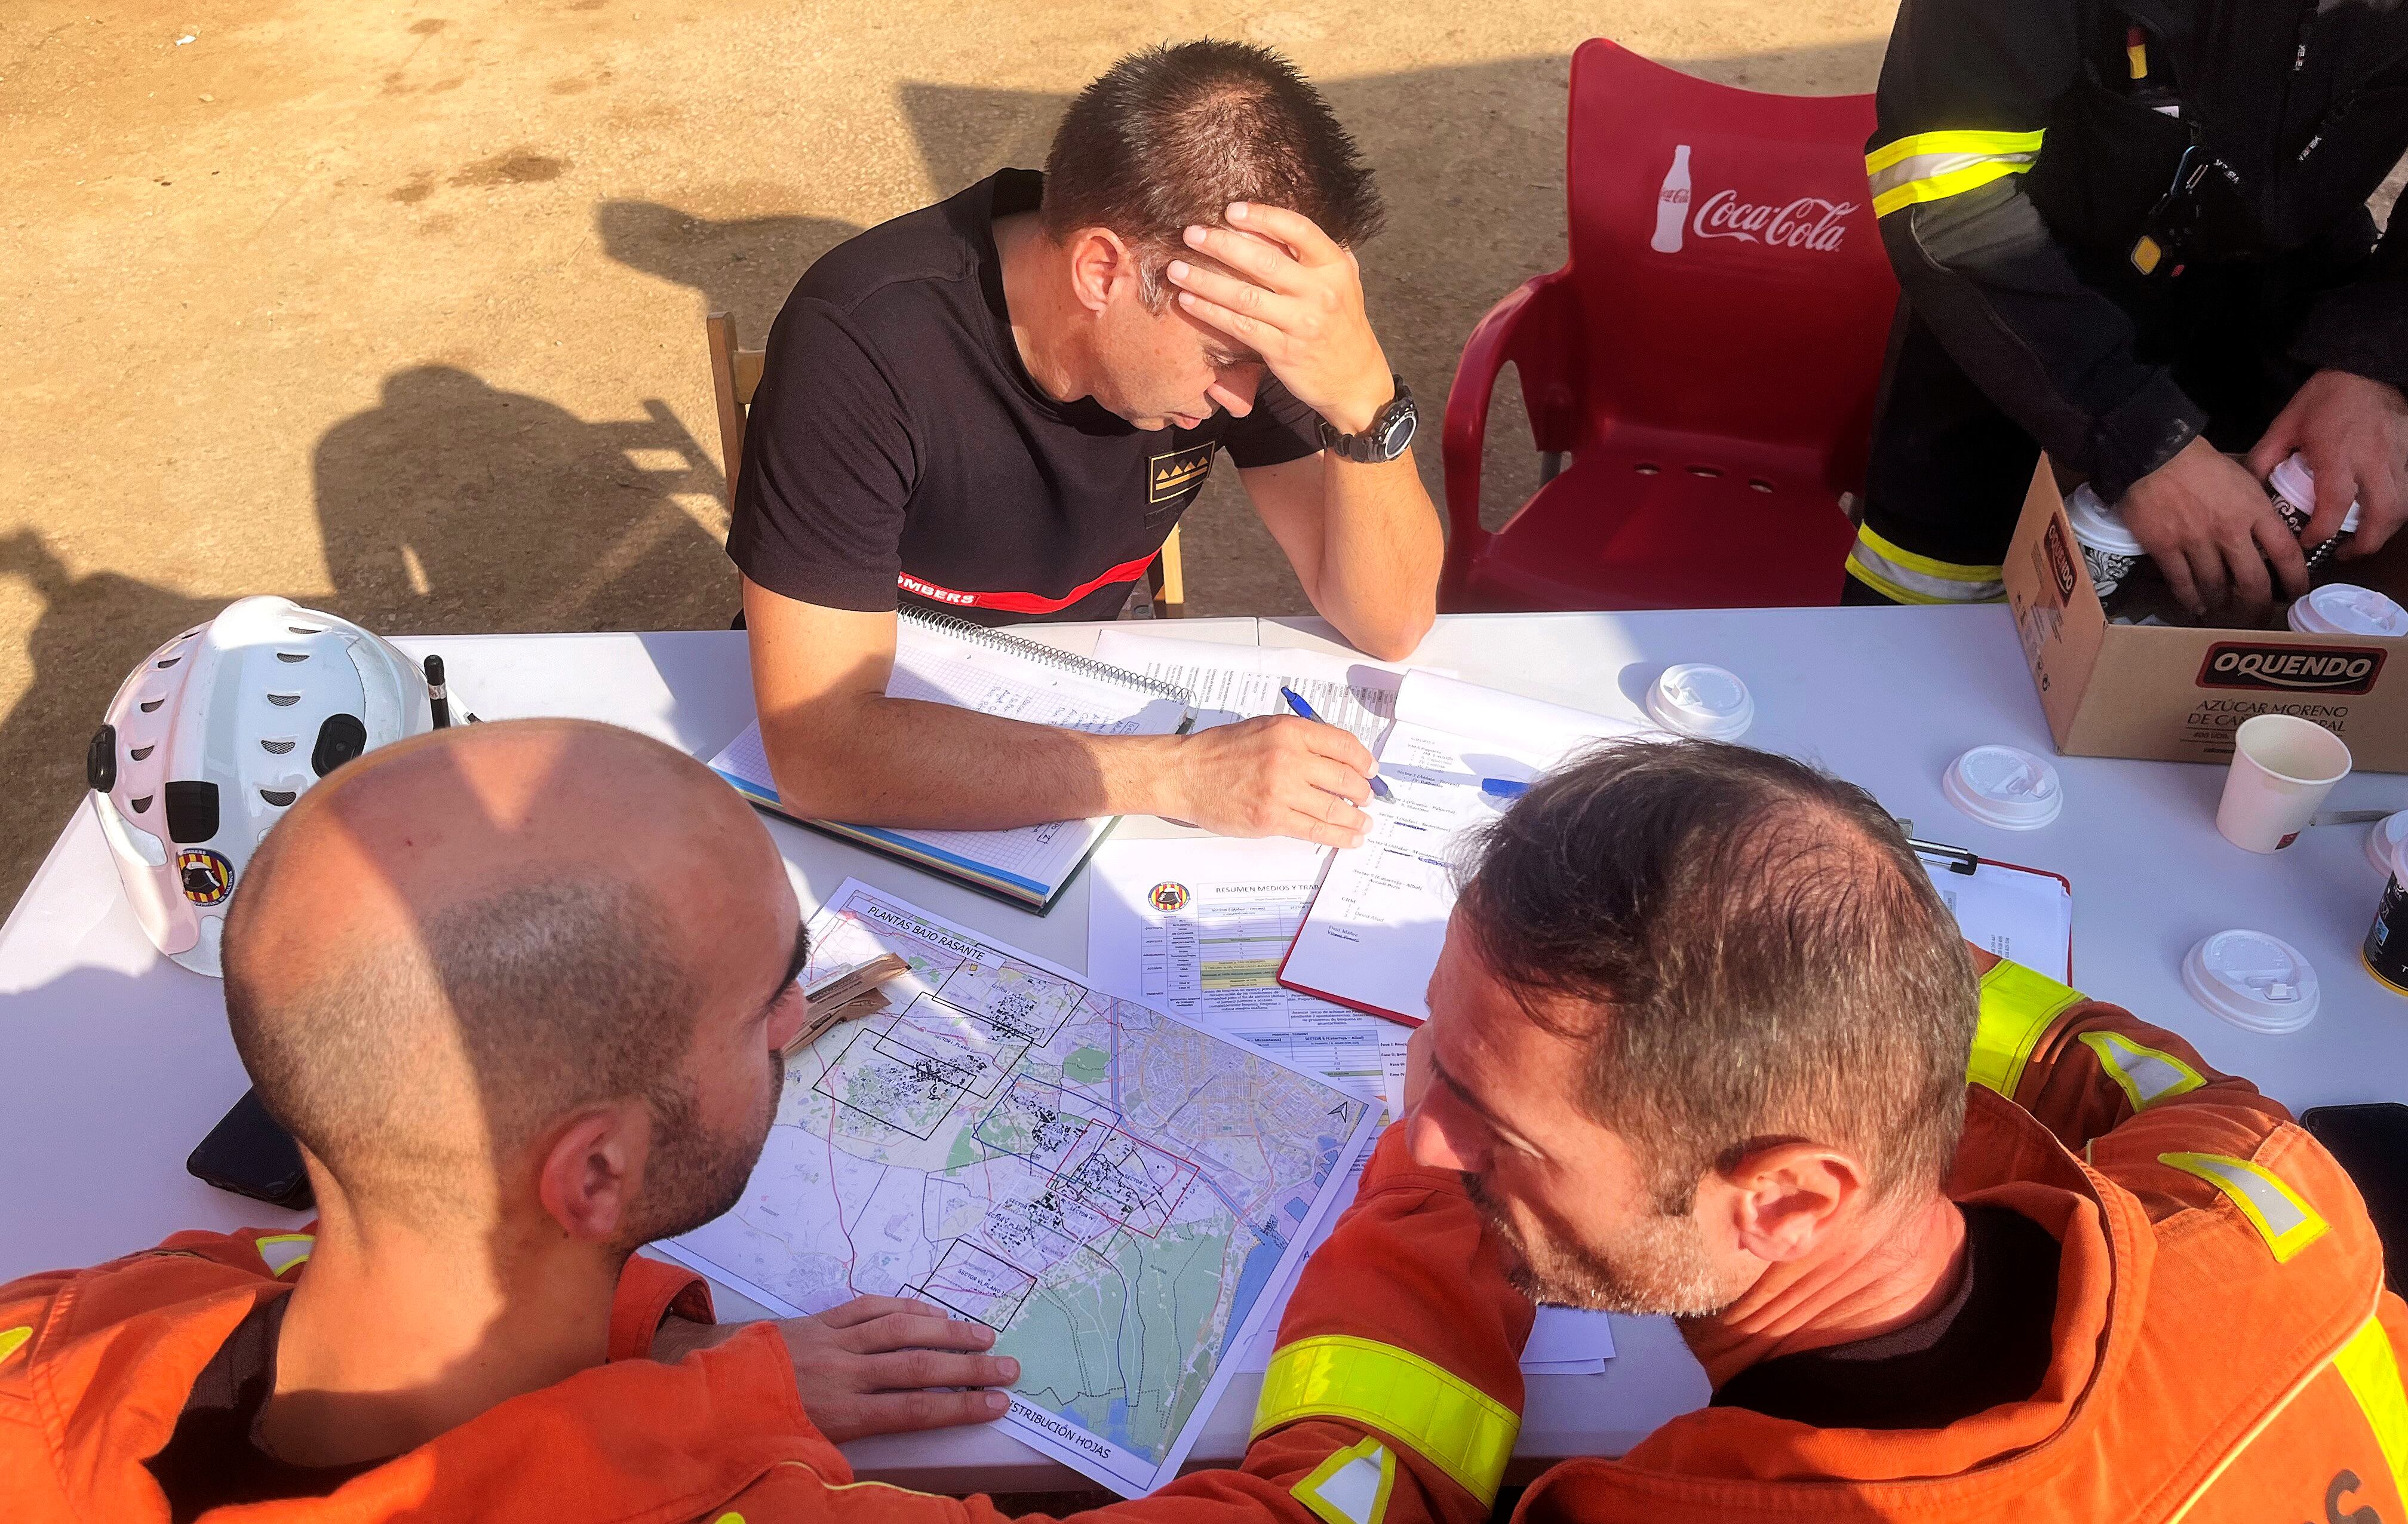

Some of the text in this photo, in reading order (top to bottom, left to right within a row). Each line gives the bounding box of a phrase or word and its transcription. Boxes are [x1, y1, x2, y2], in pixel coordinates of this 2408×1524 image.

[1694, 189, 1862, 252] Coca-Cola
[2049, 524, 2074, 594] OQUENDO
[2214, 653, 2372, 686] OQUENDO
[2196, 699, 2348, 717] AZÚCAR MORENO
[2188, 713, 2211, 724] DE
[868, 906, 985, 961] PLANTAS BAJO RASANTE
[1124, 1173, 1144, 1187] SECTOR
[1009, 1198, 1028, 1209] SECTOR
[985, 1210, 1005, 1222] SECTOR
[1069, 1206, 1089, 1219] SECTOR
[958, 1268, 977, 1282] SECTOR
[1076, 1435, 1111, 1460] HOJAS
